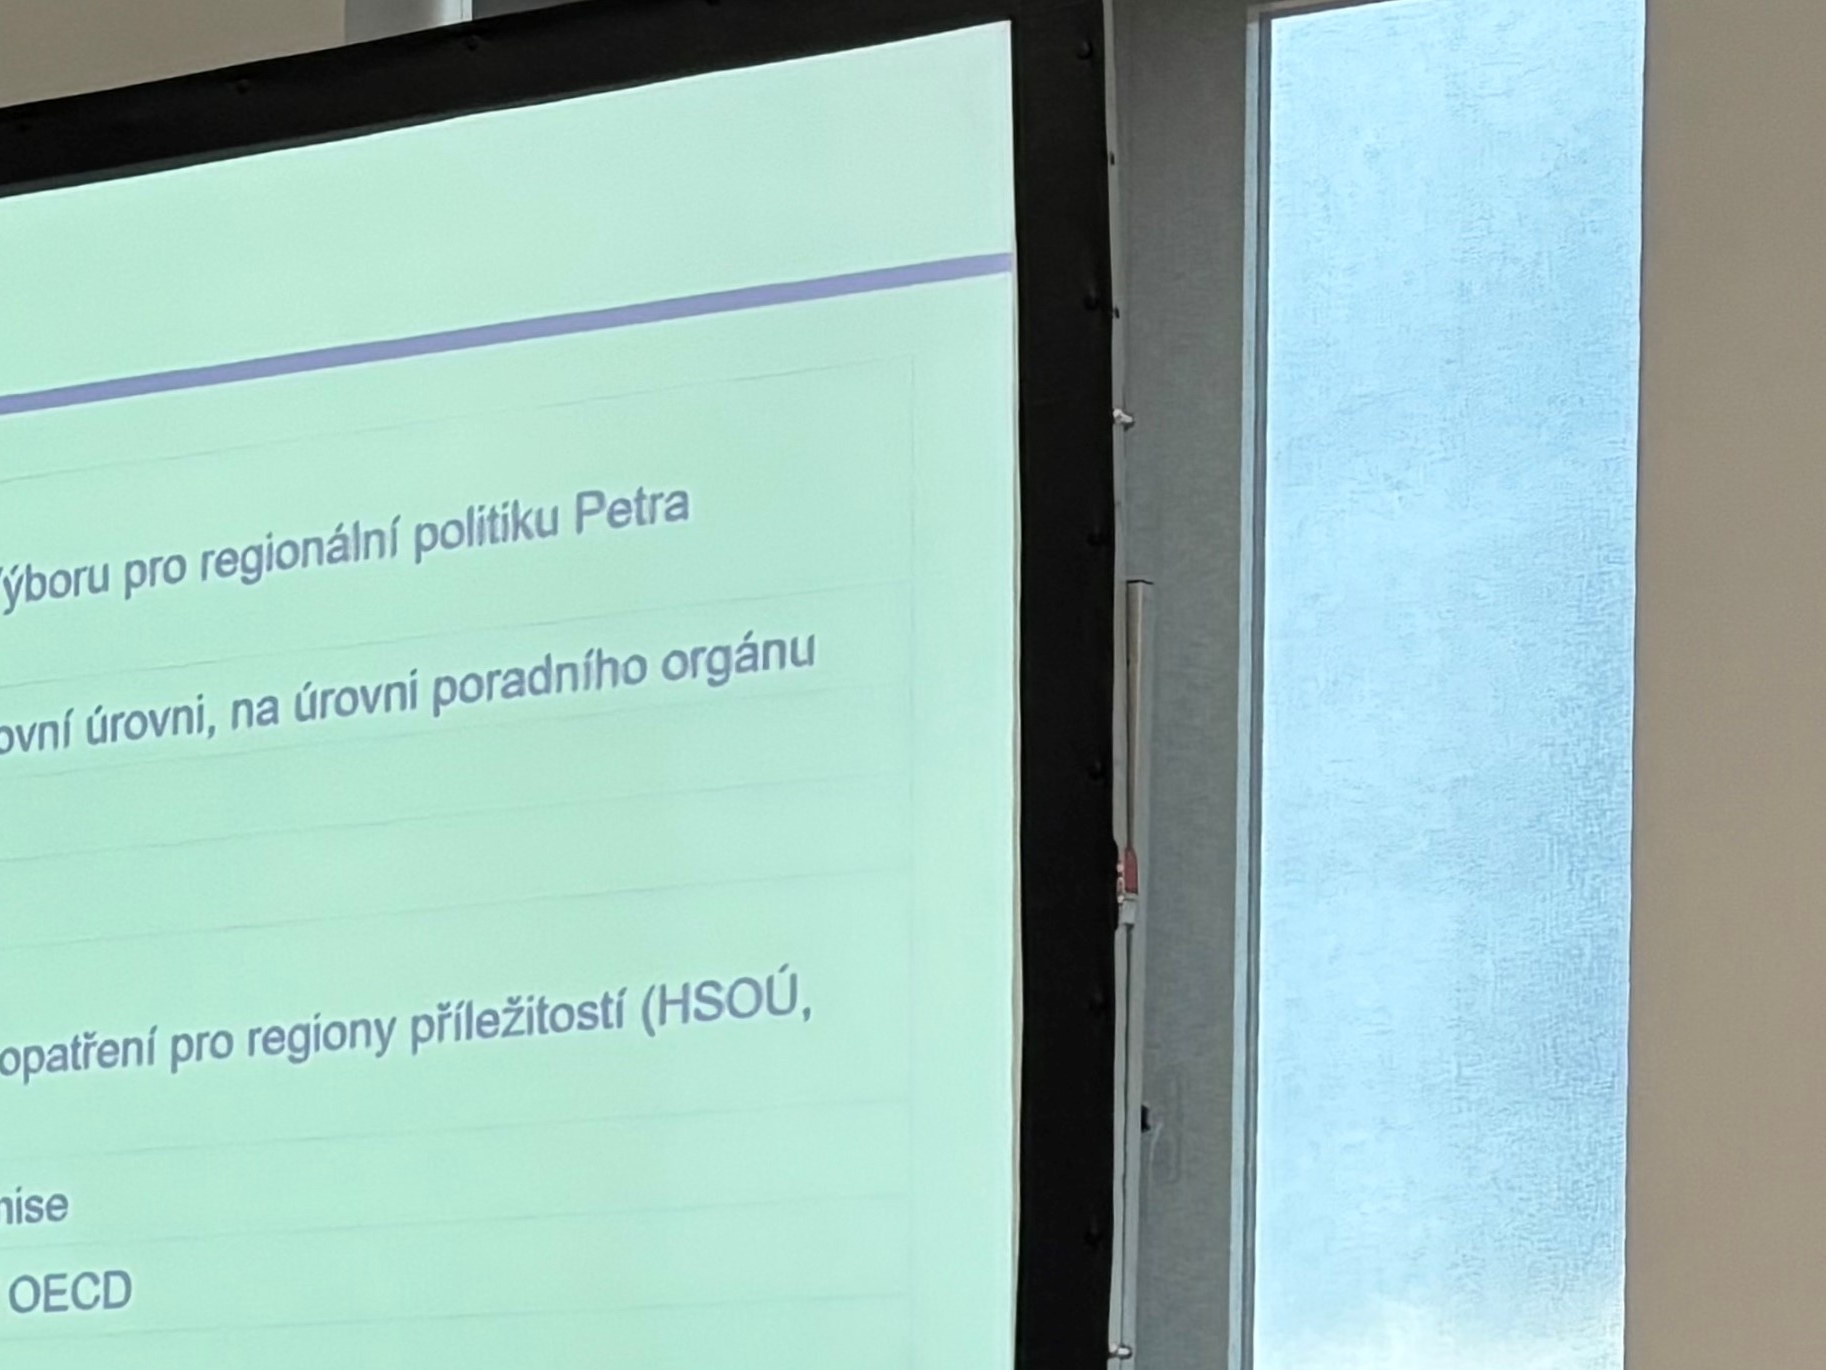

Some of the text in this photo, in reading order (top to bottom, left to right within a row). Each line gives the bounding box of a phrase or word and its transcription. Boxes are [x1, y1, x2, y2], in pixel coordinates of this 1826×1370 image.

[123, 553, 187, 602] pro
[200, 513, 402, 587] regionální
[414, 498, 560, 565] politiku
[575, 485, 689, 535] Petra
[86, 692, 216, 747] úrovni,
[230, 694, 279, 731] na
[293, 667, 418, 723] úrovni
[432, 646, 648, 719] poradního
[661, 628, 816, 688] orgánu
[170, 1029, 235, 1075] pro
[247, 1011, 398, 1065] regiony
[410, 985, 628, 1057] příležitostí
[641, 962, 812, 1039] (HSOÚ,
[8, 1269, 132, 1314] OECD
